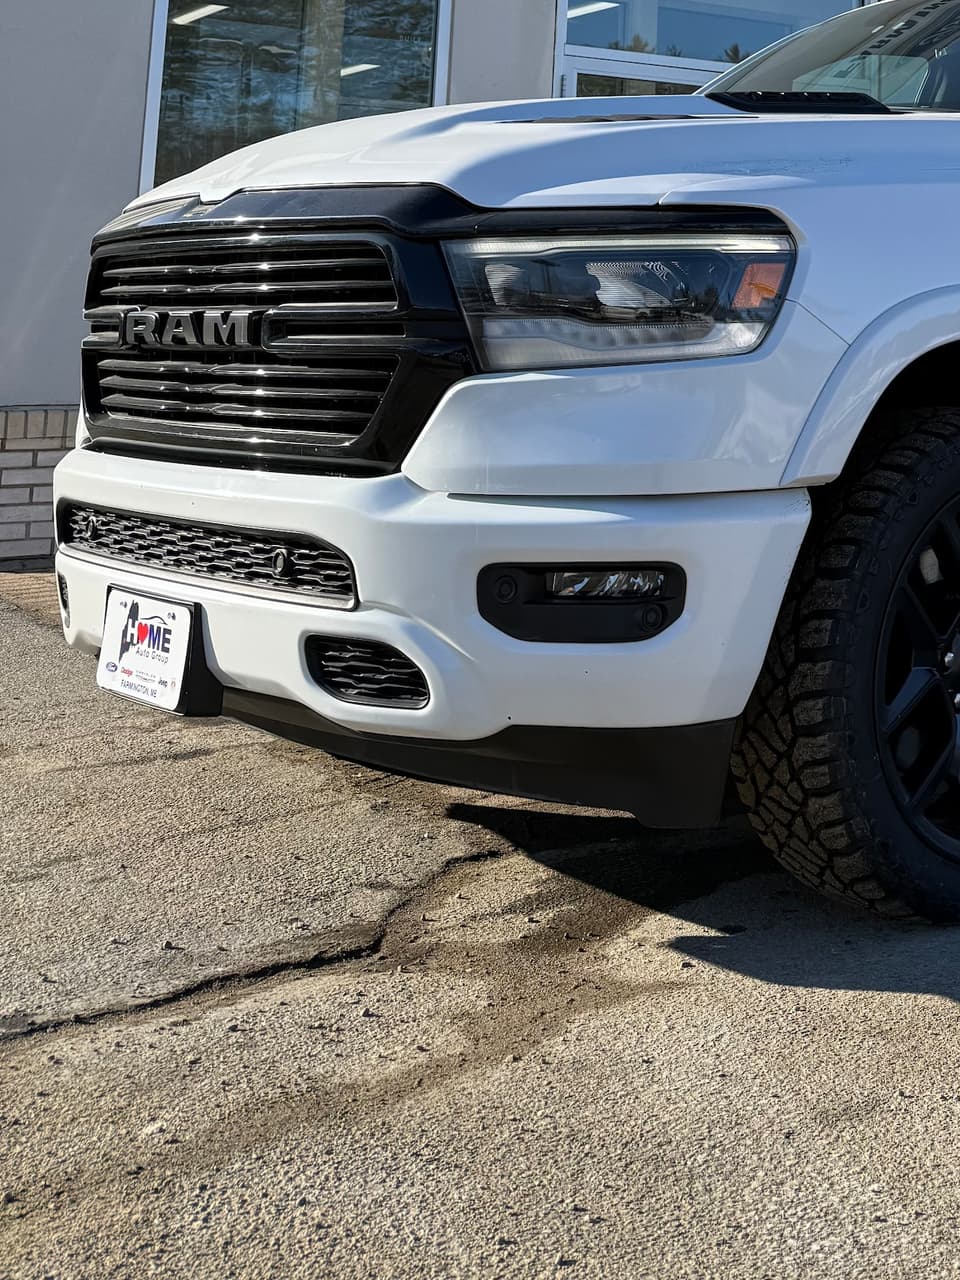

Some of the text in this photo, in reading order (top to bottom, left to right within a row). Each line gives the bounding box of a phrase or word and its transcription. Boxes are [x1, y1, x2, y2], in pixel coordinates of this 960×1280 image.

[126, 309, 253, 346] RAM
[135, 647, 169, 664] Auto Group
